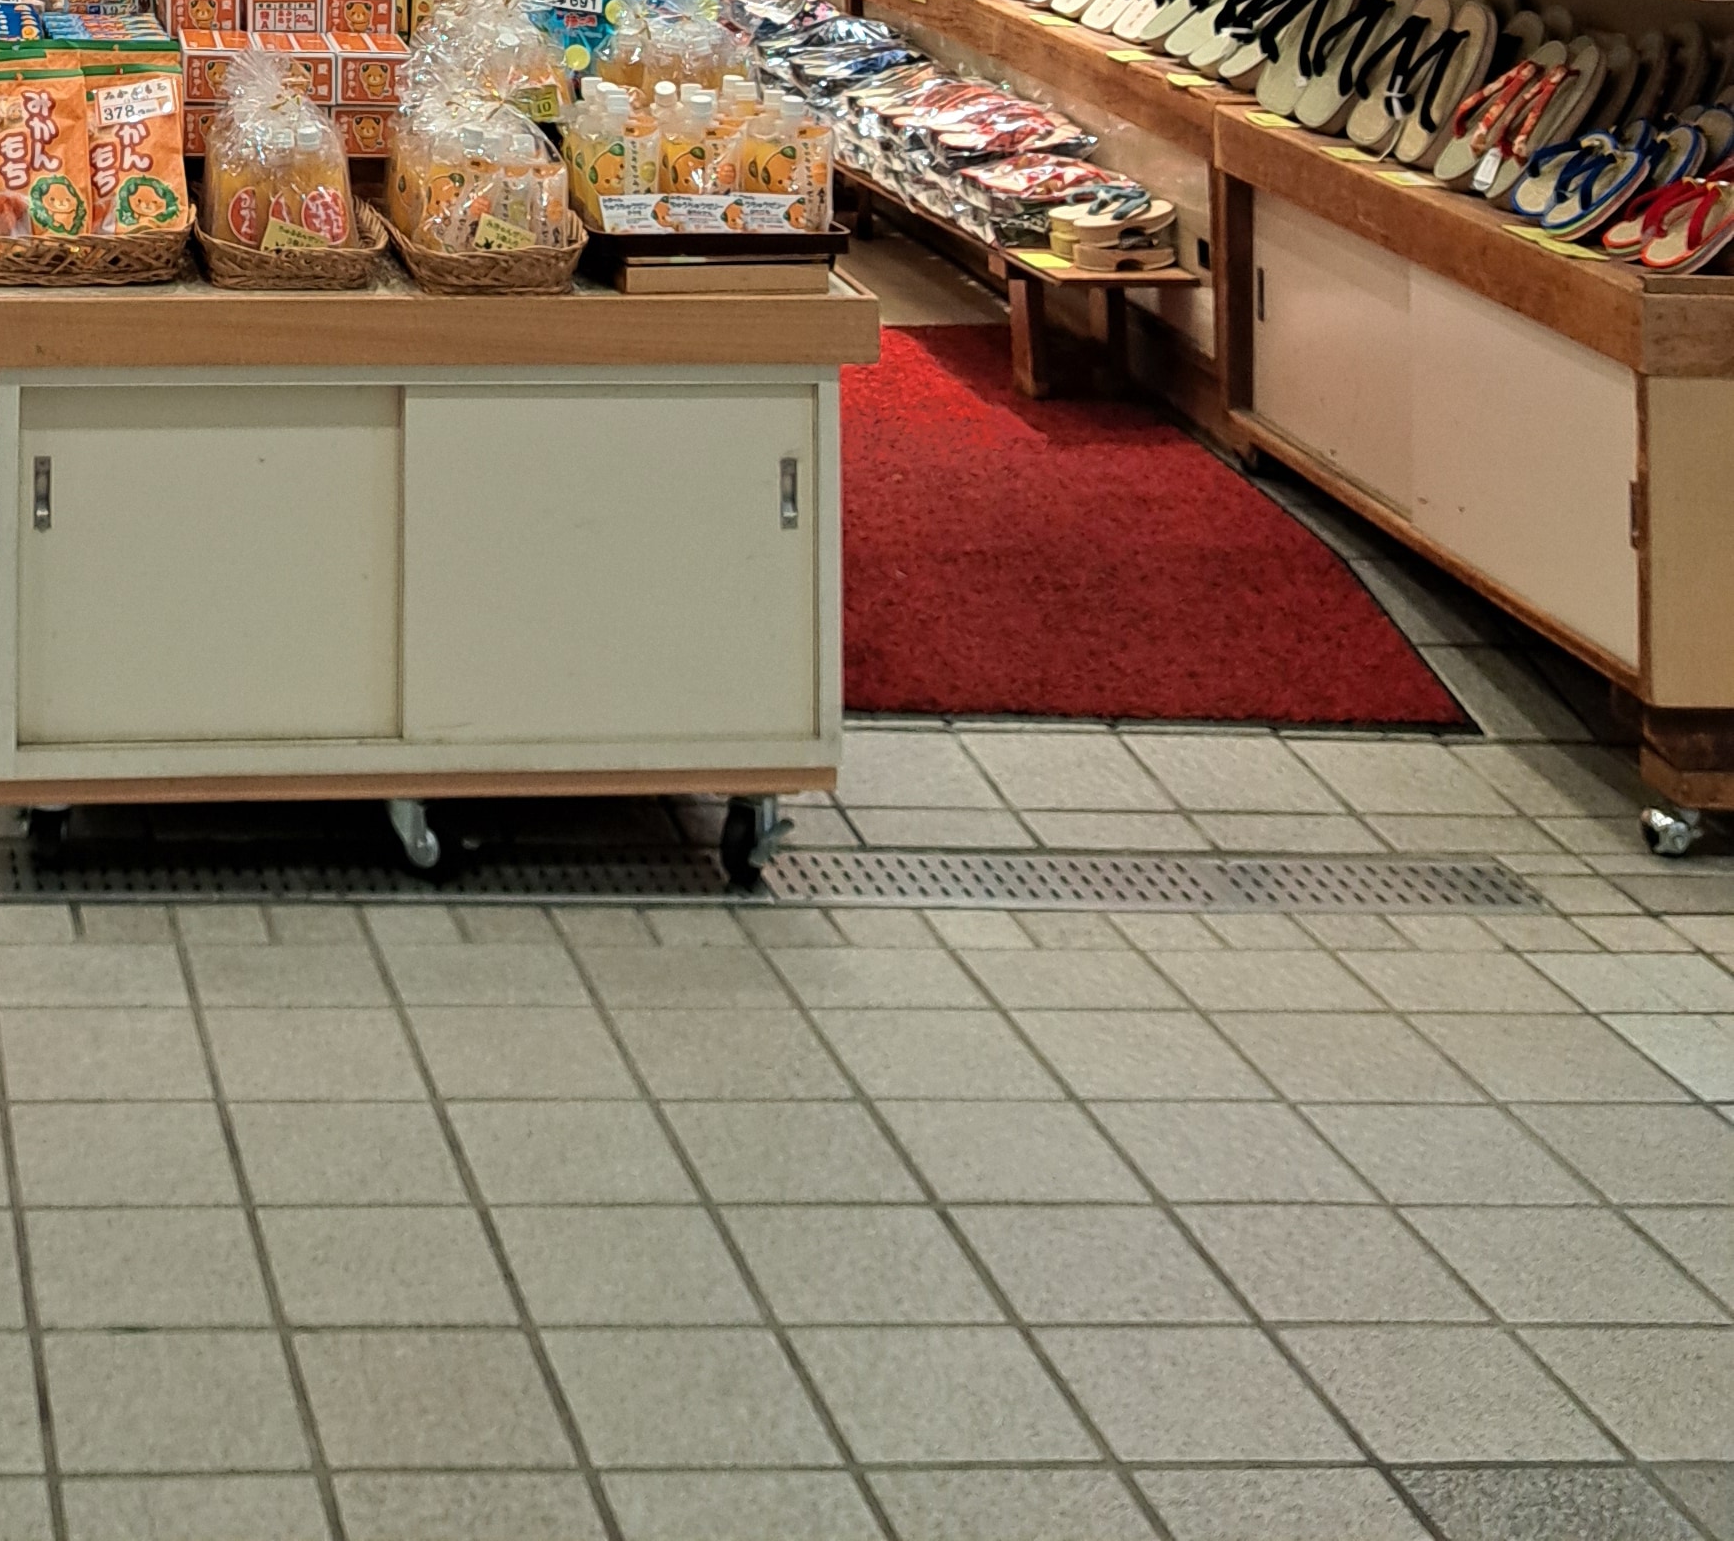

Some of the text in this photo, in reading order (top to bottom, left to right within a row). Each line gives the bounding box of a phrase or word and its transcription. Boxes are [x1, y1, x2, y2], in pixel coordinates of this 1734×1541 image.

[22, 91, 60, 170] みかん
[0, 135, 29, 188] もち
[91, 145, 117, 196] もち
